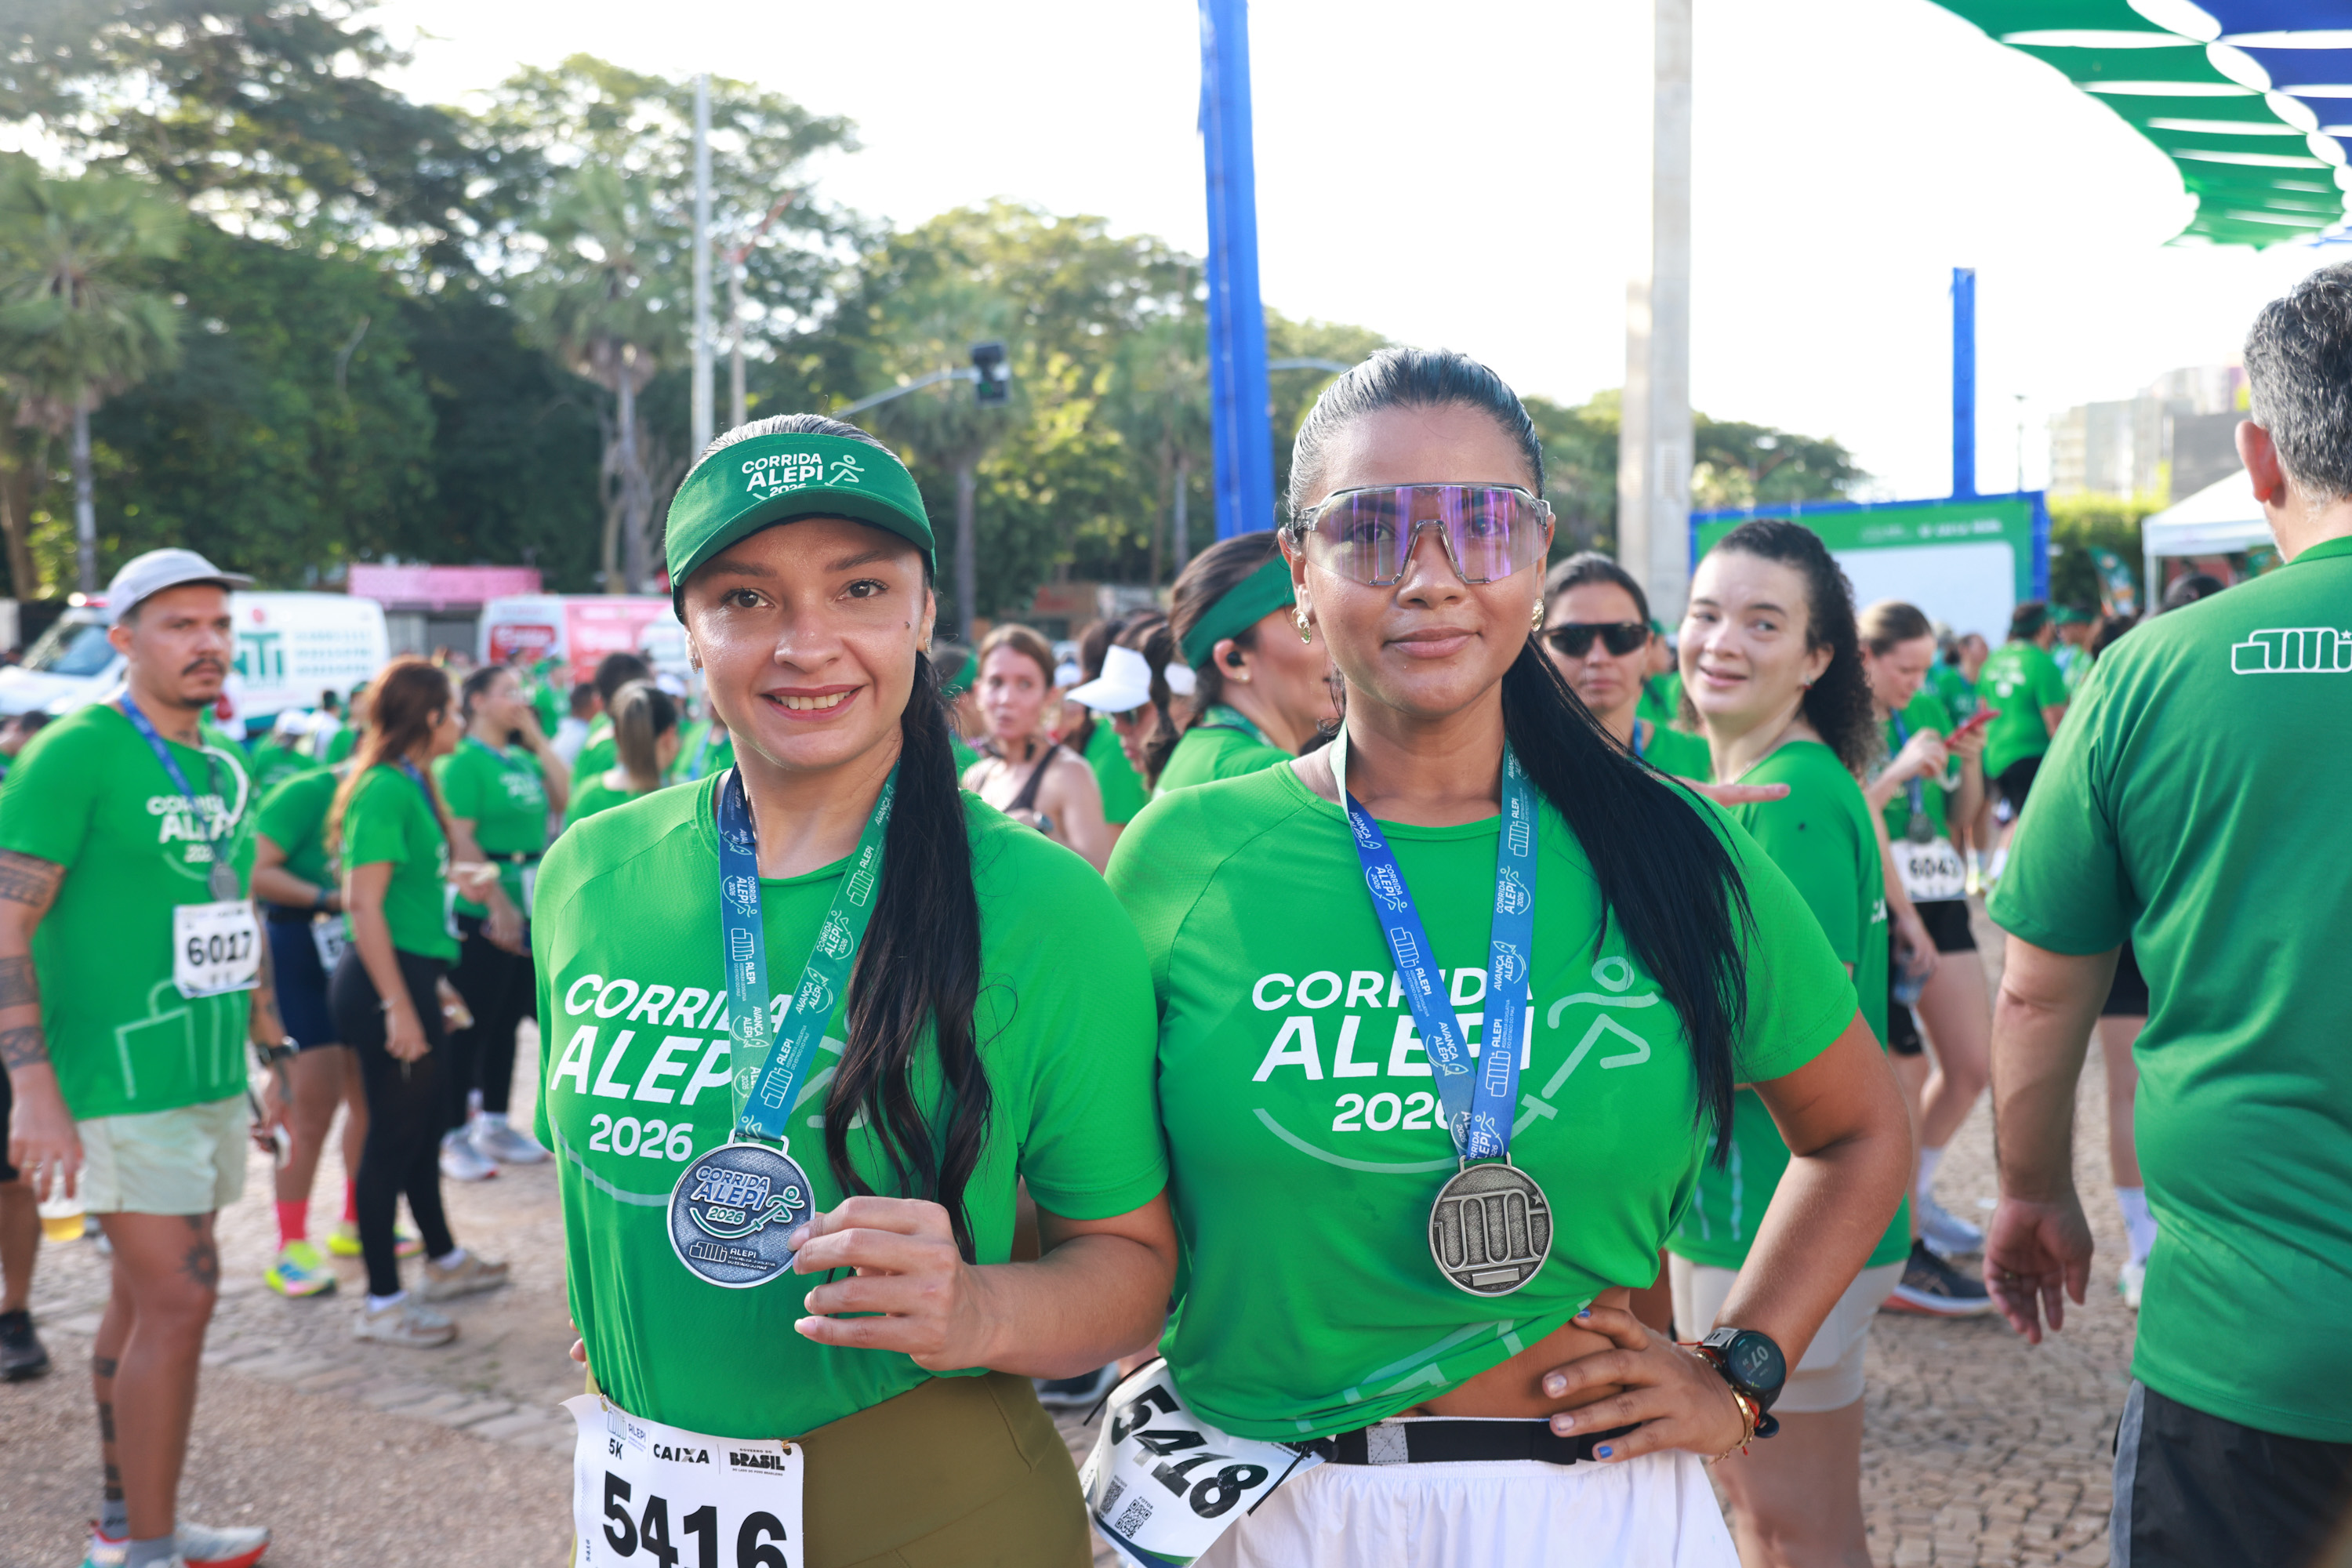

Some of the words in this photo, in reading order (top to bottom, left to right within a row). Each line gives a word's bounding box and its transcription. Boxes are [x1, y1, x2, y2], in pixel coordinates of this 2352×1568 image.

[742, 453, 822, 474] CORRIDA
[746, 465, 823, 492] ALEPI
[874, 797, 891, 826] AVANÇA
[1349, 811, 1372, 839] AVANÇA
[858, 845, 874, 869] ALEPI
[736, 876, 750, 905] ALEPI
[747, 876, 757, 904] CORRIDA
[1371, 873, 1381, 890] 2026
[1374, 866, 1396, 896] ALEPI
[1385, 864, 1403, 895] CORRIDA
[1496, 880, 1506, 913] CORRIDA
[1504, 881, 1517, 914] ALEPI
[188, 931, 252, 967] 6017
[816, 921, 833, 952] CORRIDA
[824, 924, 844, 958] ALEPI
[838, 938, 848, 953] 2026
[746, 961, 756, 985] ALEPI
[1415, 967, 1432, 996] ALEPI
[1494, 955, 1504, 991] AVANÇA
[1504, 955, 1514, 981] ALEPI
[795, 982, 814, 1014] AVANÇA
[808, 985, 823, 1010] ALEPI
[743, 1016, 753, 1038] ALEPI
[753, 1006, 764, 1036] AVANÇA
[1491, 1018, 1502, 1047] ALEPI
[776, 1038, 794, 1065] ALEPI
[1433, 1036, 1450, 1063] ALEPI
[1438, 1022, 1459, 1061] AVANÇA
[550, 1025, 732, 1105] ALEP
[589, 1113, 694, 1162] 2026
[1456, 1123, 1467, 1143] 2026
[697, 1167, 769, 1190] CORRIDA
[691, 1182, 767, 1210] ALEPI
[707, 1207, 745, 1225] 2026
[730, 1247, 757, 1258] ALEPI
[628, 1423, 646, 1443] ALEPI
[608, 1438, 622, 1461] 5K
[653, 1443, 710, 1465] CAIXA
[730, 1452, 786, 1472] BRASIL
[1111, 1384, 1269, 1519] 5418
[1138, 1496, 1154, 1510] FOTOS
[603, 1470, 787, 1568] 5416
